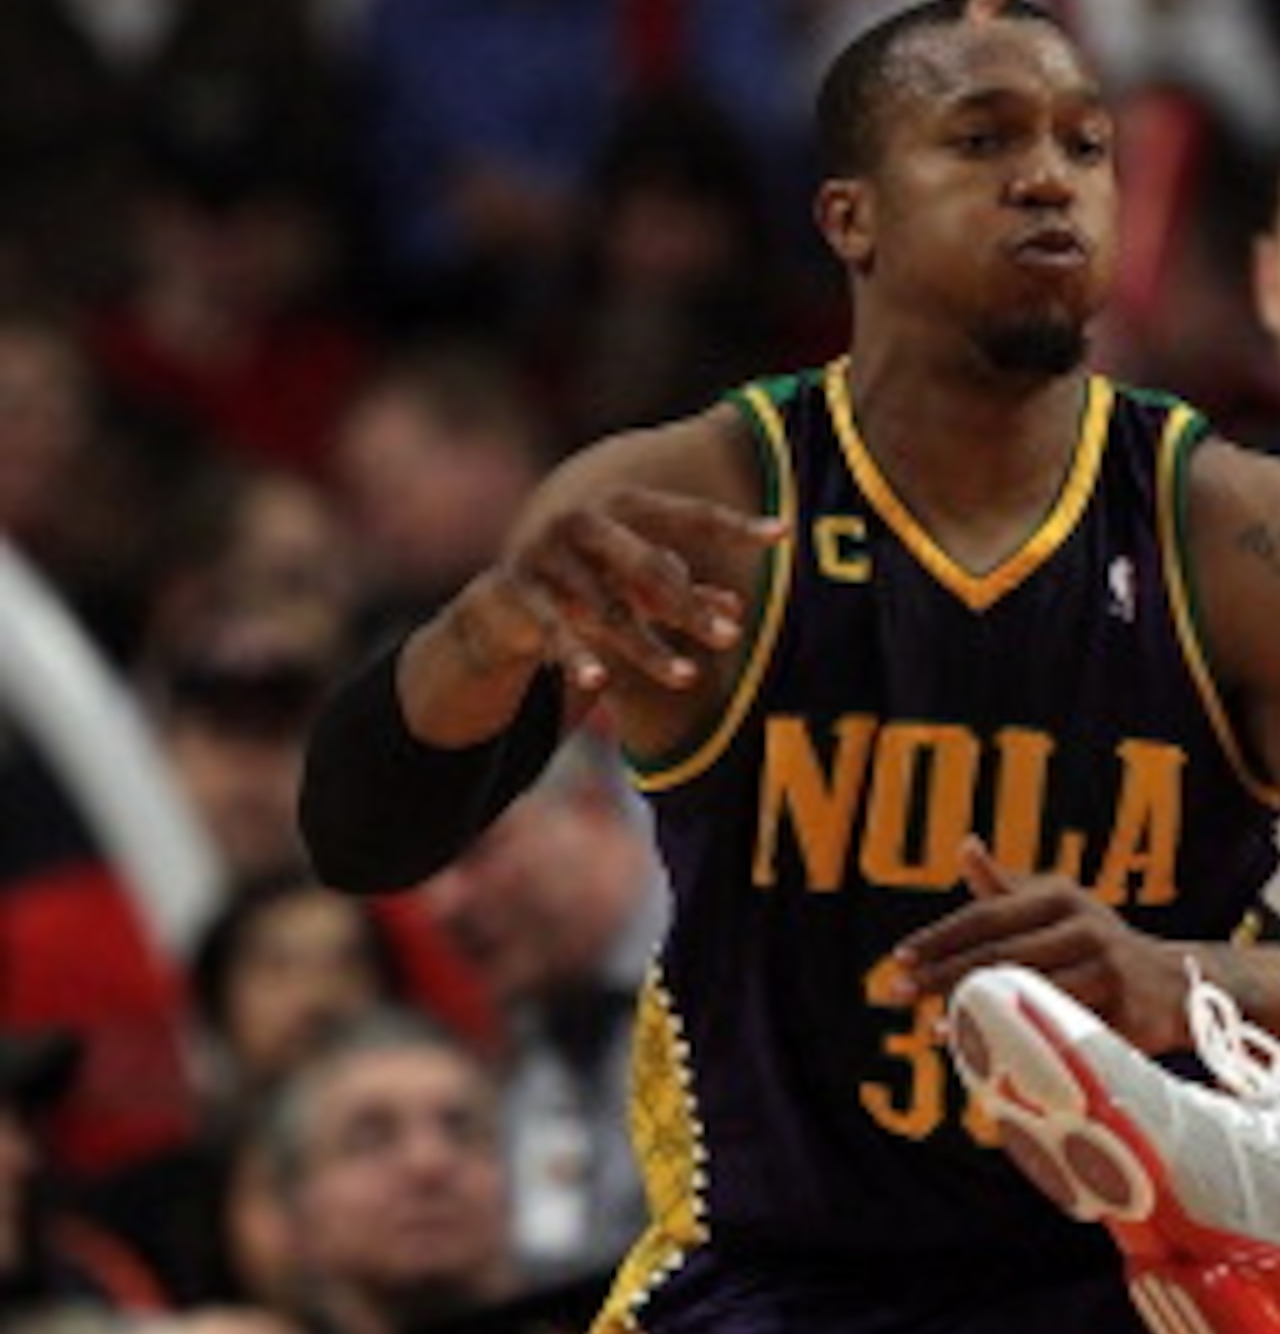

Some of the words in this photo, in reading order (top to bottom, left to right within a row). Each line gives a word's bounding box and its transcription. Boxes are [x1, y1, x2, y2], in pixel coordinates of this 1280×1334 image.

[816, 517, 871, 582] C
[751, 715, 1186, 906] NOLA
[859, 956, 1004, 1147] 3
